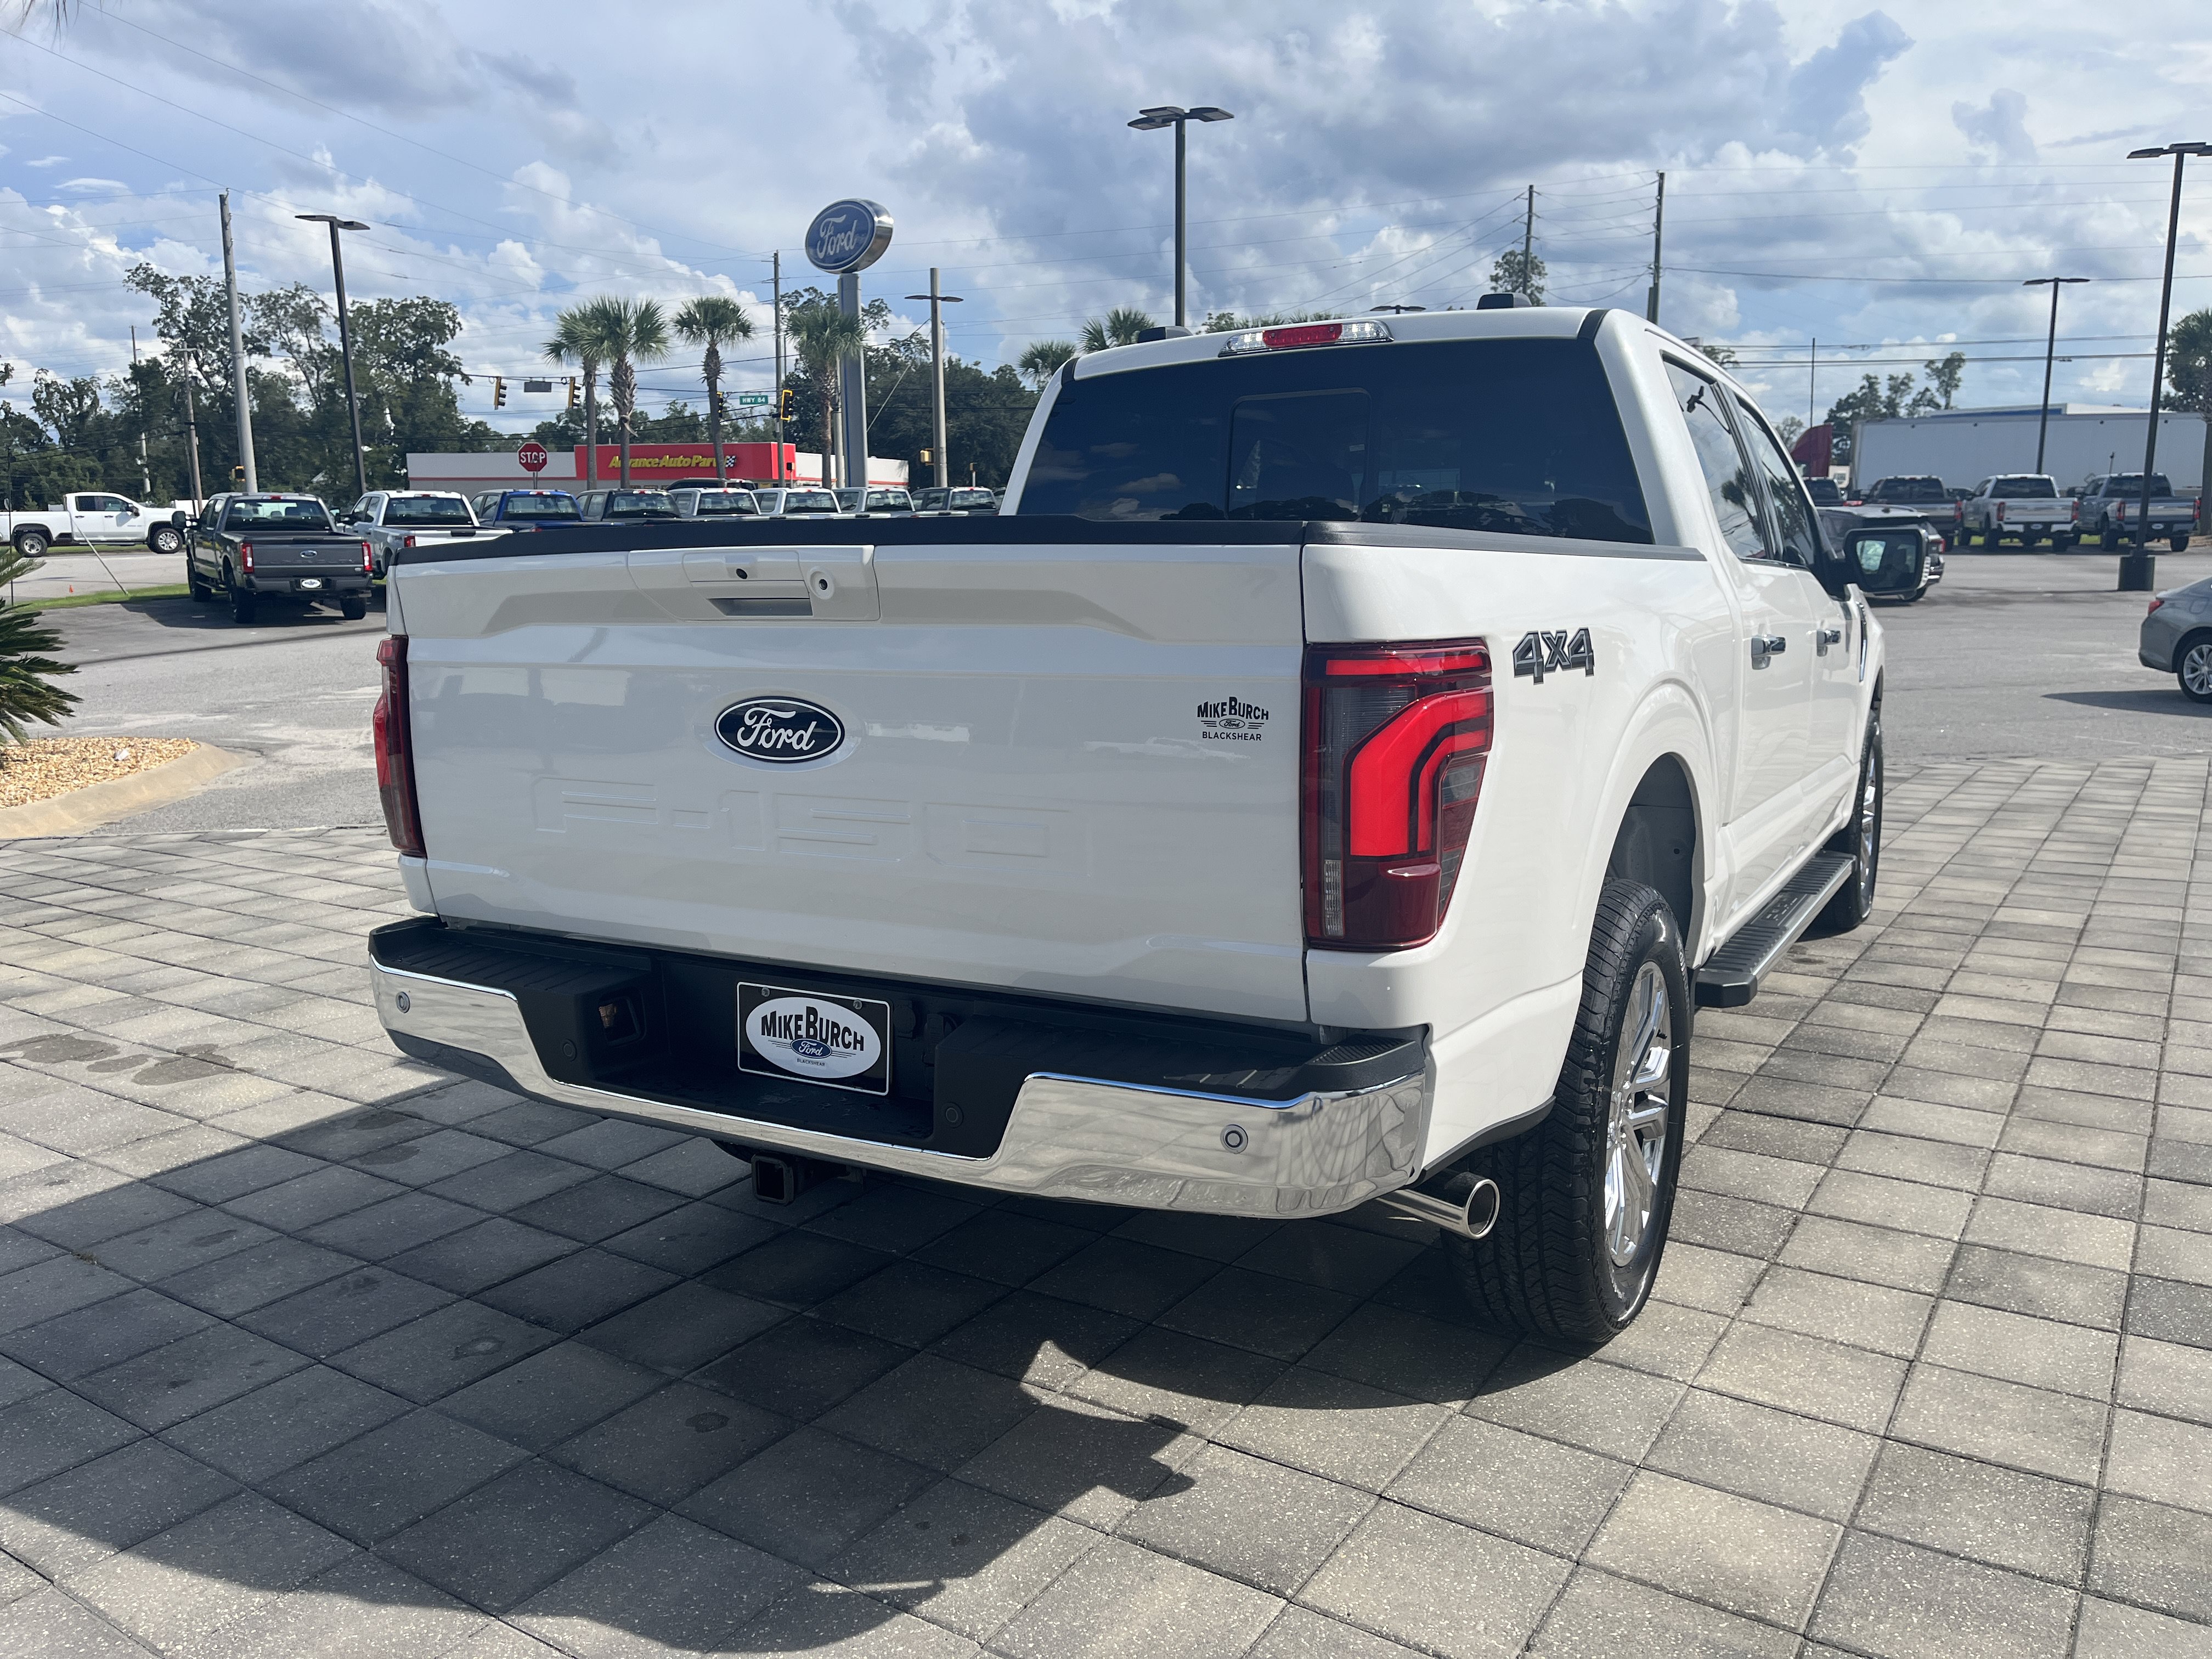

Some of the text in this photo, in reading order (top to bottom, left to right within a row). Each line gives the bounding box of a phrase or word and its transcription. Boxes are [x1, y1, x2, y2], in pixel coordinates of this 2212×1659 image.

[817, 215, 857, 258] Ford
[520, 452, 546, 464] STOP
[659, 455, 691, 467] Auto
[737, 707, 817, 751] Ford
[1202, 731, 1262, 741] BLACKSHEAR
[531, 775, 1092, 878] F-150
[798, 1041, 823, 1056] Ford
[797, 1058, 826, 1067] BLACKSHEAR
